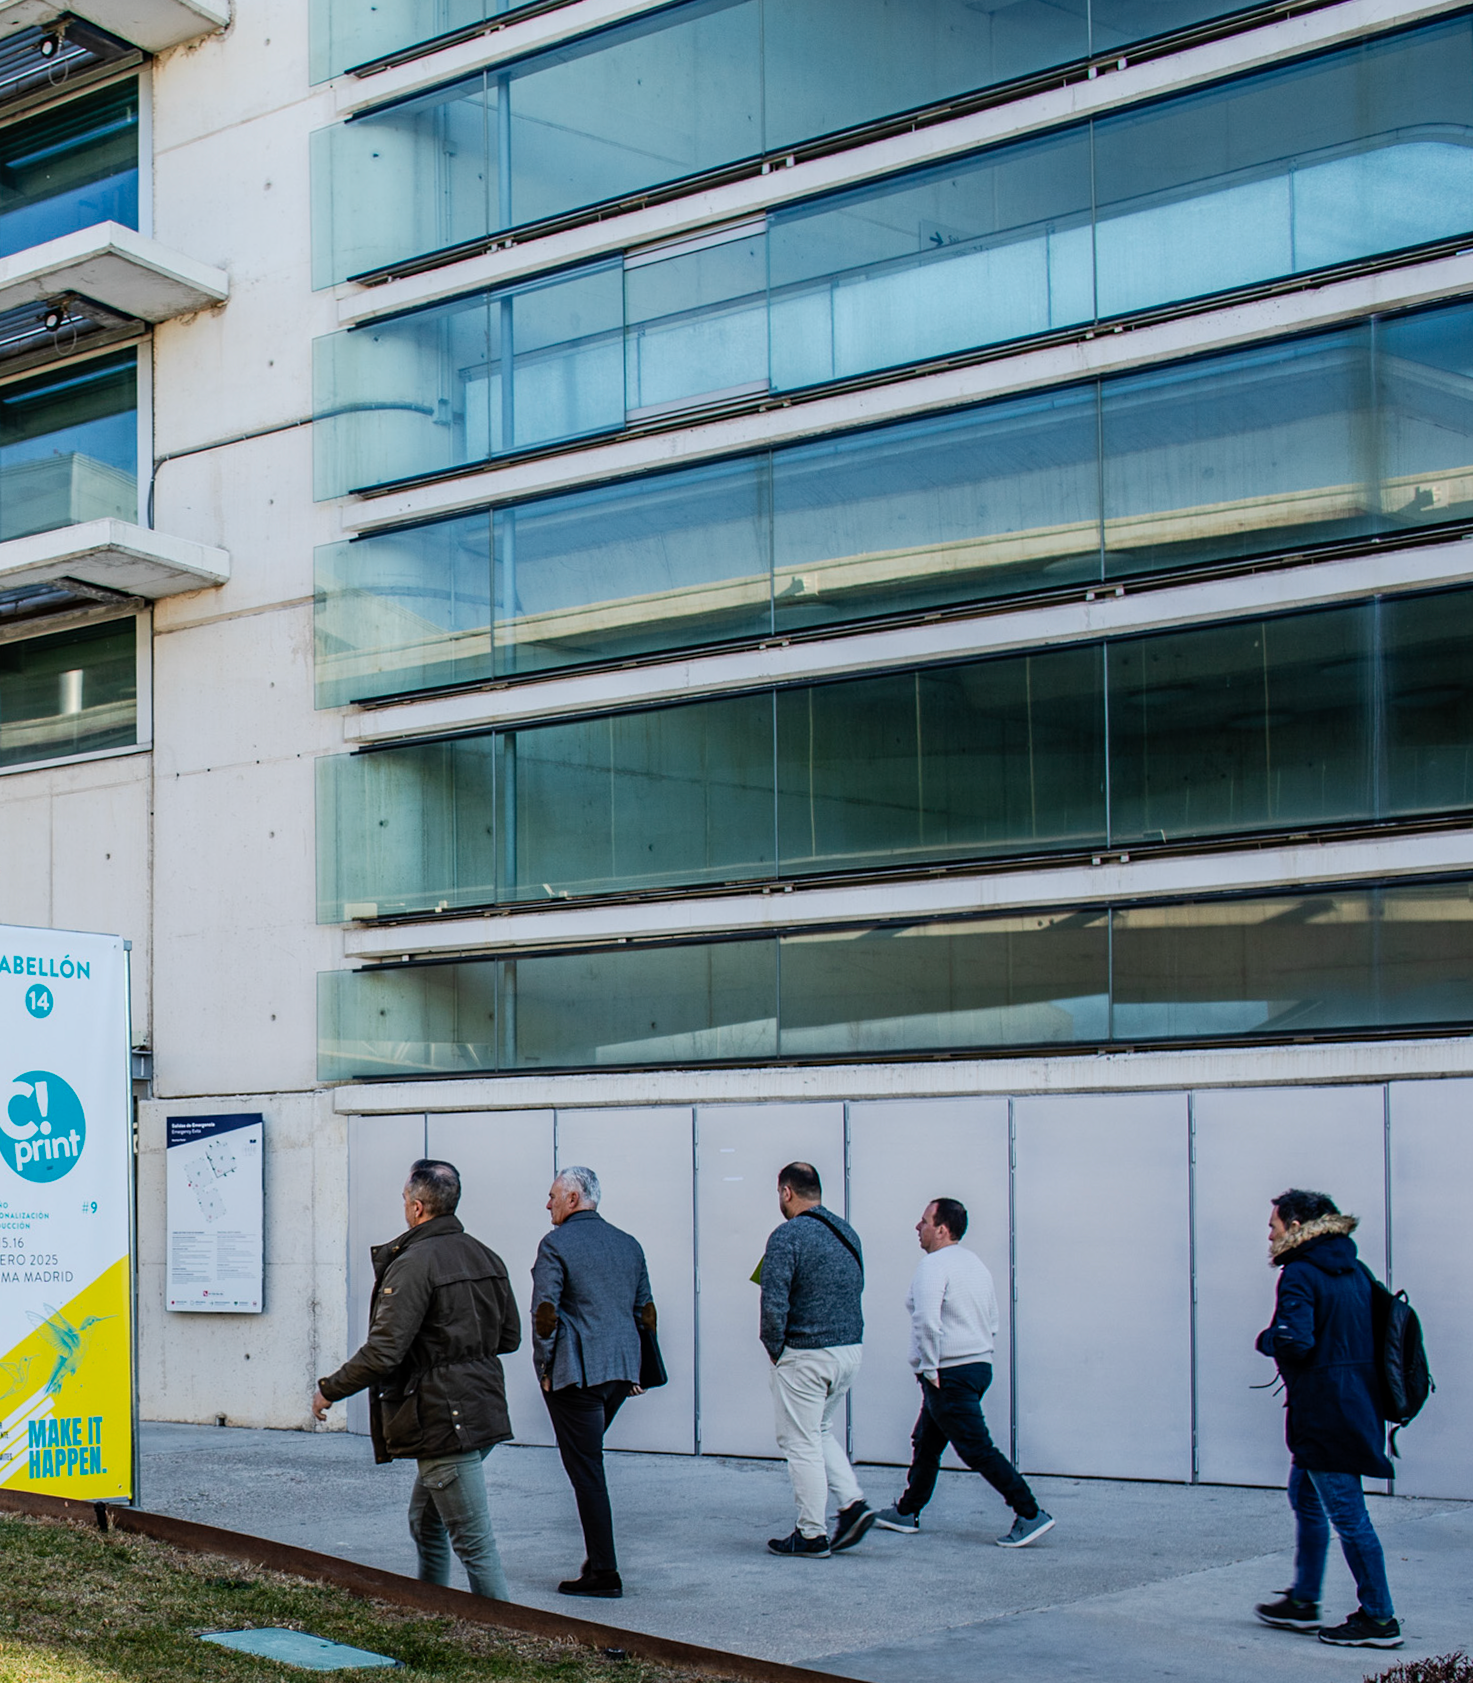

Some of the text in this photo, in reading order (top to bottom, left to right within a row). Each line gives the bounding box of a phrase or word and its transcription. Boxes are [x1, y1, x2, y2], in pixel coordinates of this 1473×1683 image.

[28, 990, 50, 1011] 14
[14, 1129, 81, 1172] print
[30, 1254, 59, 1266] 2025
[23, 1271, 74, 1283] MADRID
[28, 1416, 103, 1449] MAKE IT
[28, 1445, 107, 1479] HAPPEN.
